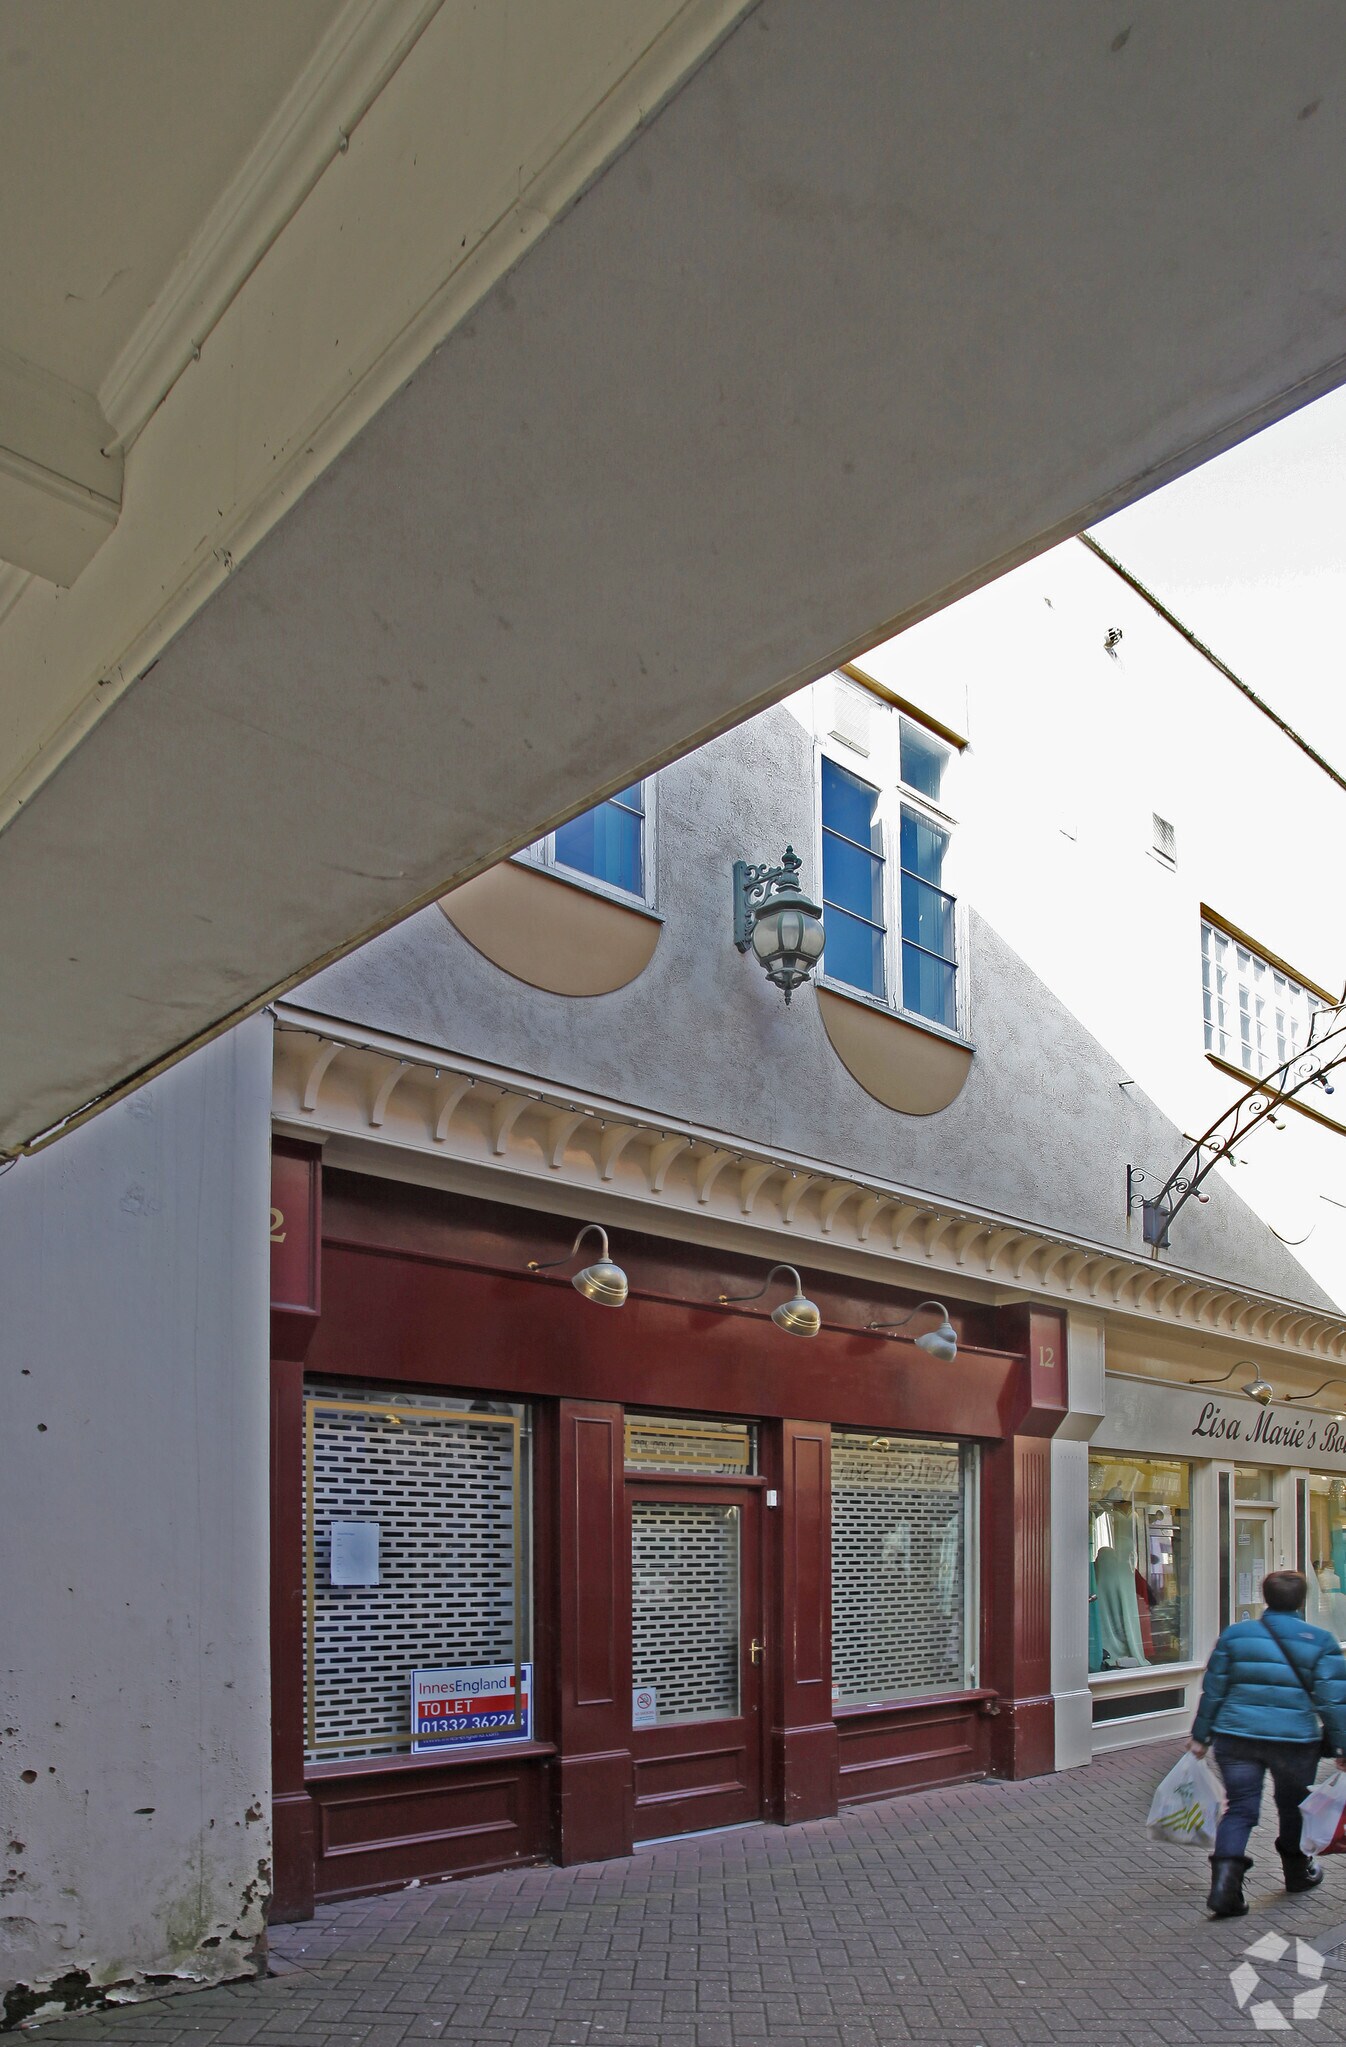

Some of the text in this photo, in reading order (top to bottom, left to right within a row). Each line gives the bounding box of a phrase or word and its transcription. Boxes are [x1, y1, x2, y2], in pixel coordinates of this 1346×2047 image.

[1039, 1345, 1056, 1368] 12
[1192, 1402, 1241, 1441] Lisa
[1246, 1410, 1317, 1450] Marie's
[419, 1676, 507, 1695] InnesEngland
[421, 1699, 473, 1716] TO LET
[421, 1717, 467, 1735] 01332
